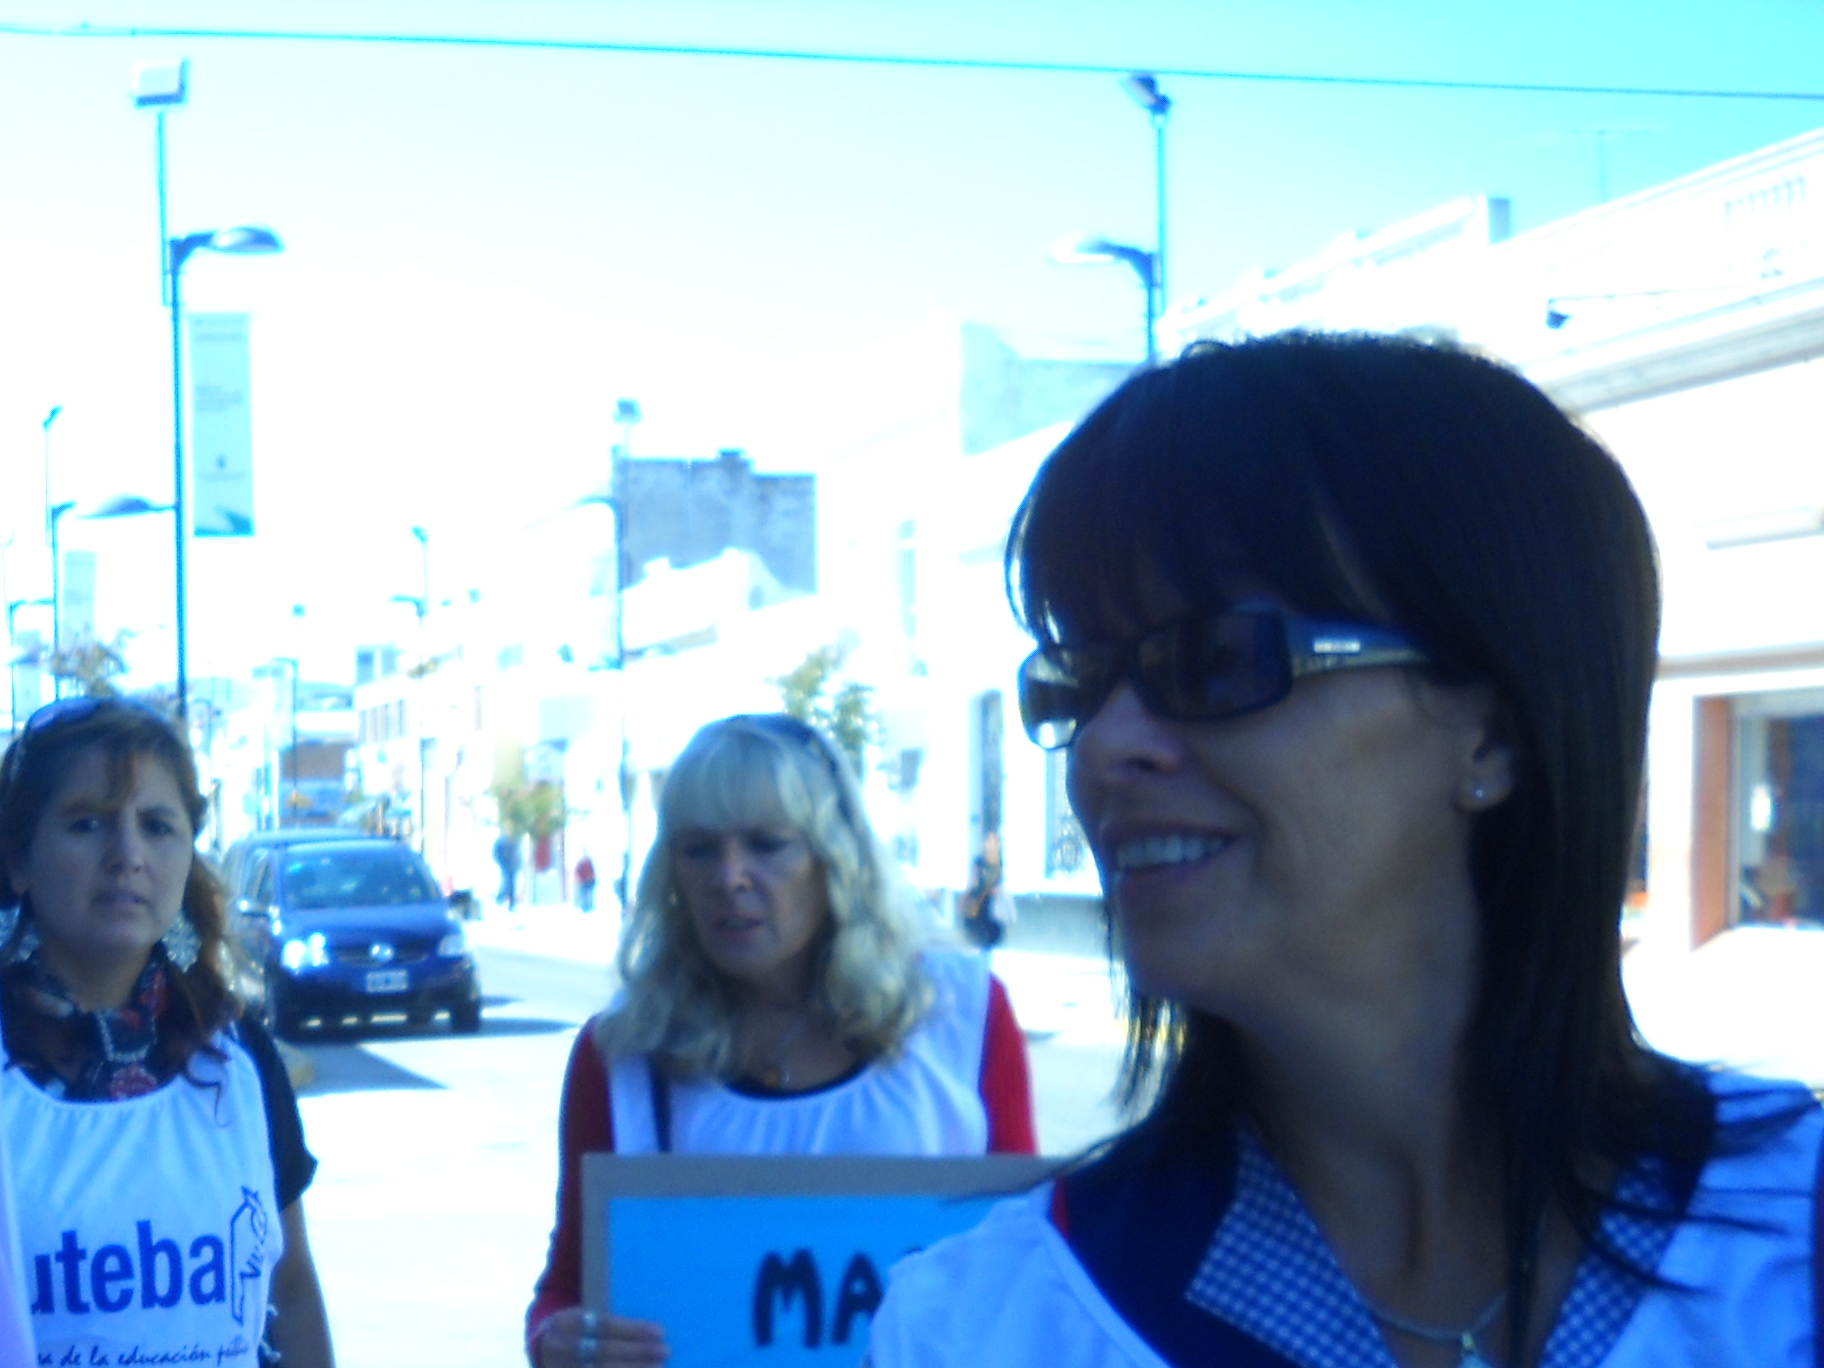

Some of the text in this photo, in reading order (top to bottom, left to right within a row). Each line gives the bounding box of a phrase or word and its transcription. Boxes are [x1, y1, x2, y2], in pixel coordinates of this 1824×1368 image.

[752, 1246, 890, 1349] MA
[60, 1344, 81, 1366] de
[90, 1344, 109, 1366] la
